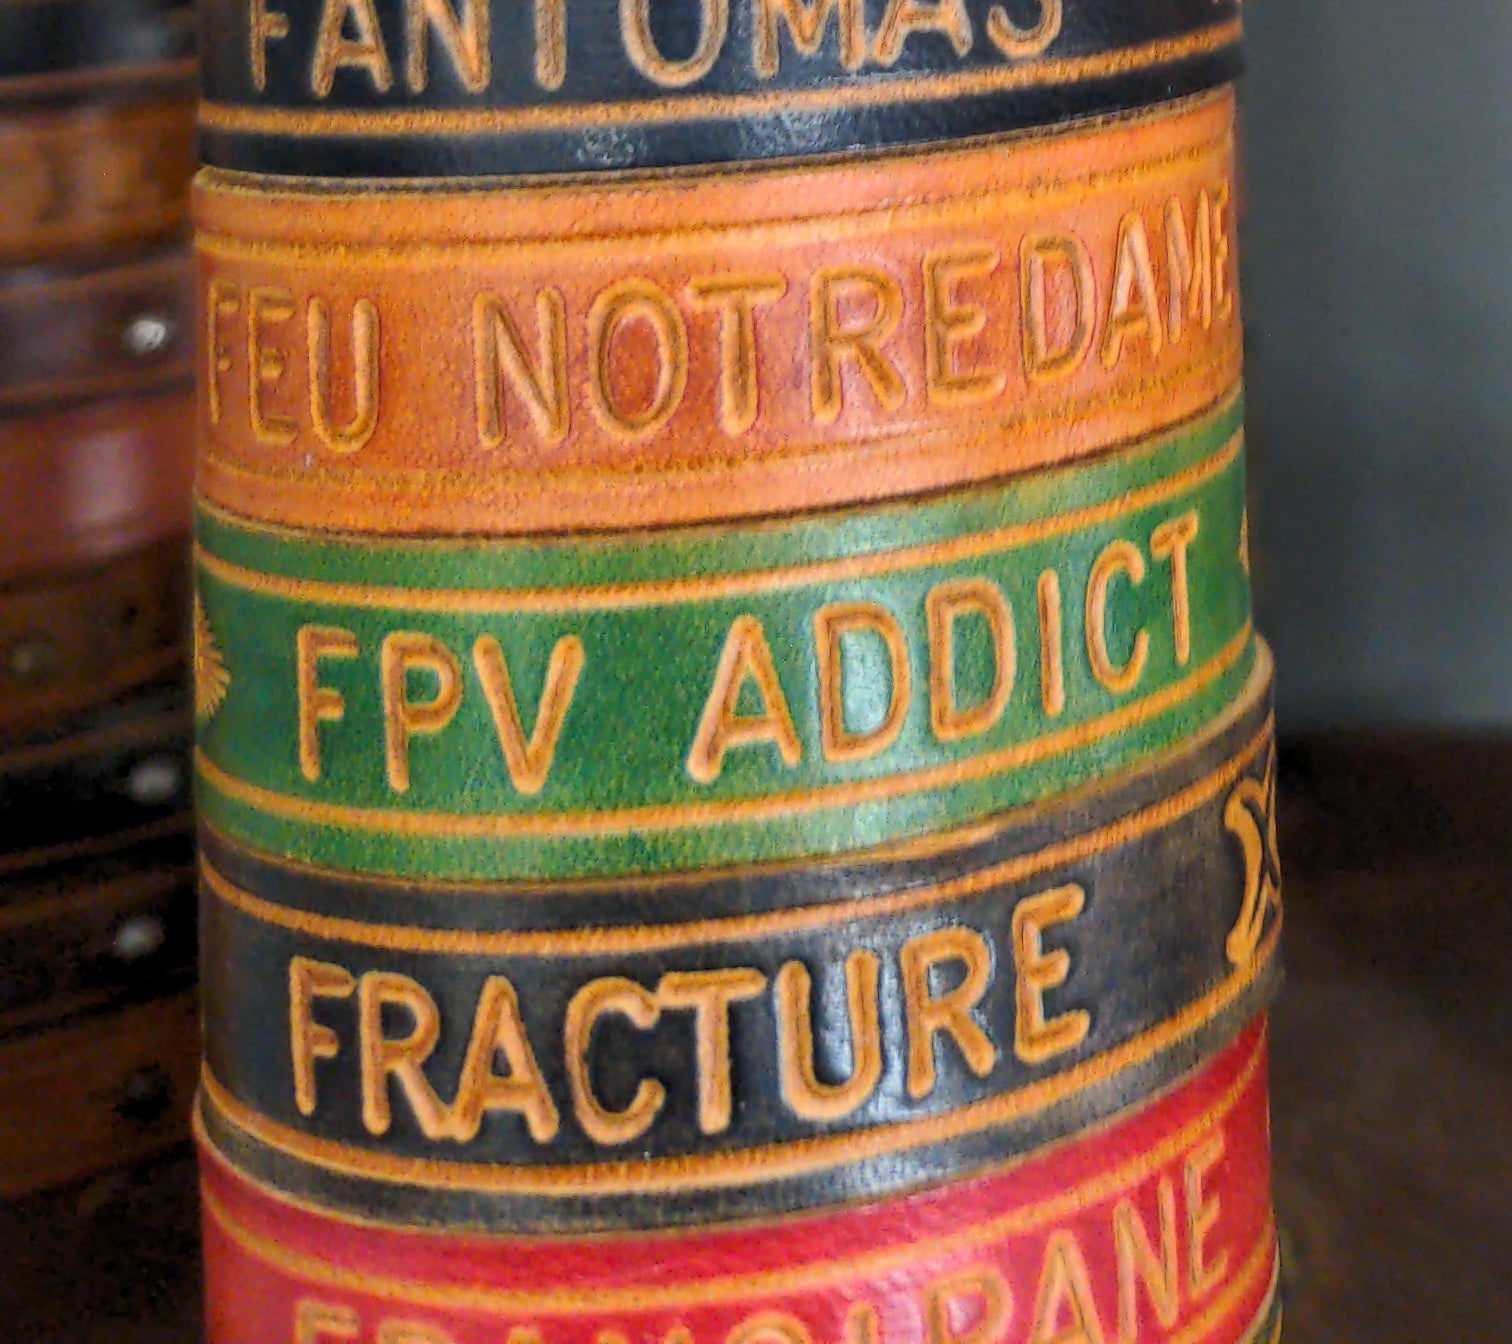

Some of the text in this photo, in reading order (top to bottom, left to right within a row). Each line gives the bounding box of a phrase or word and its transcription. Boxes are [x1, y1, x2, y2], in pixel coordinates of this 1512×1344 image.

[207, 278, 381, 454] FEU
[296, 511, 1199, 794] FPV ADDICT
[289, 883, 1091, 1146] FRACTURE
